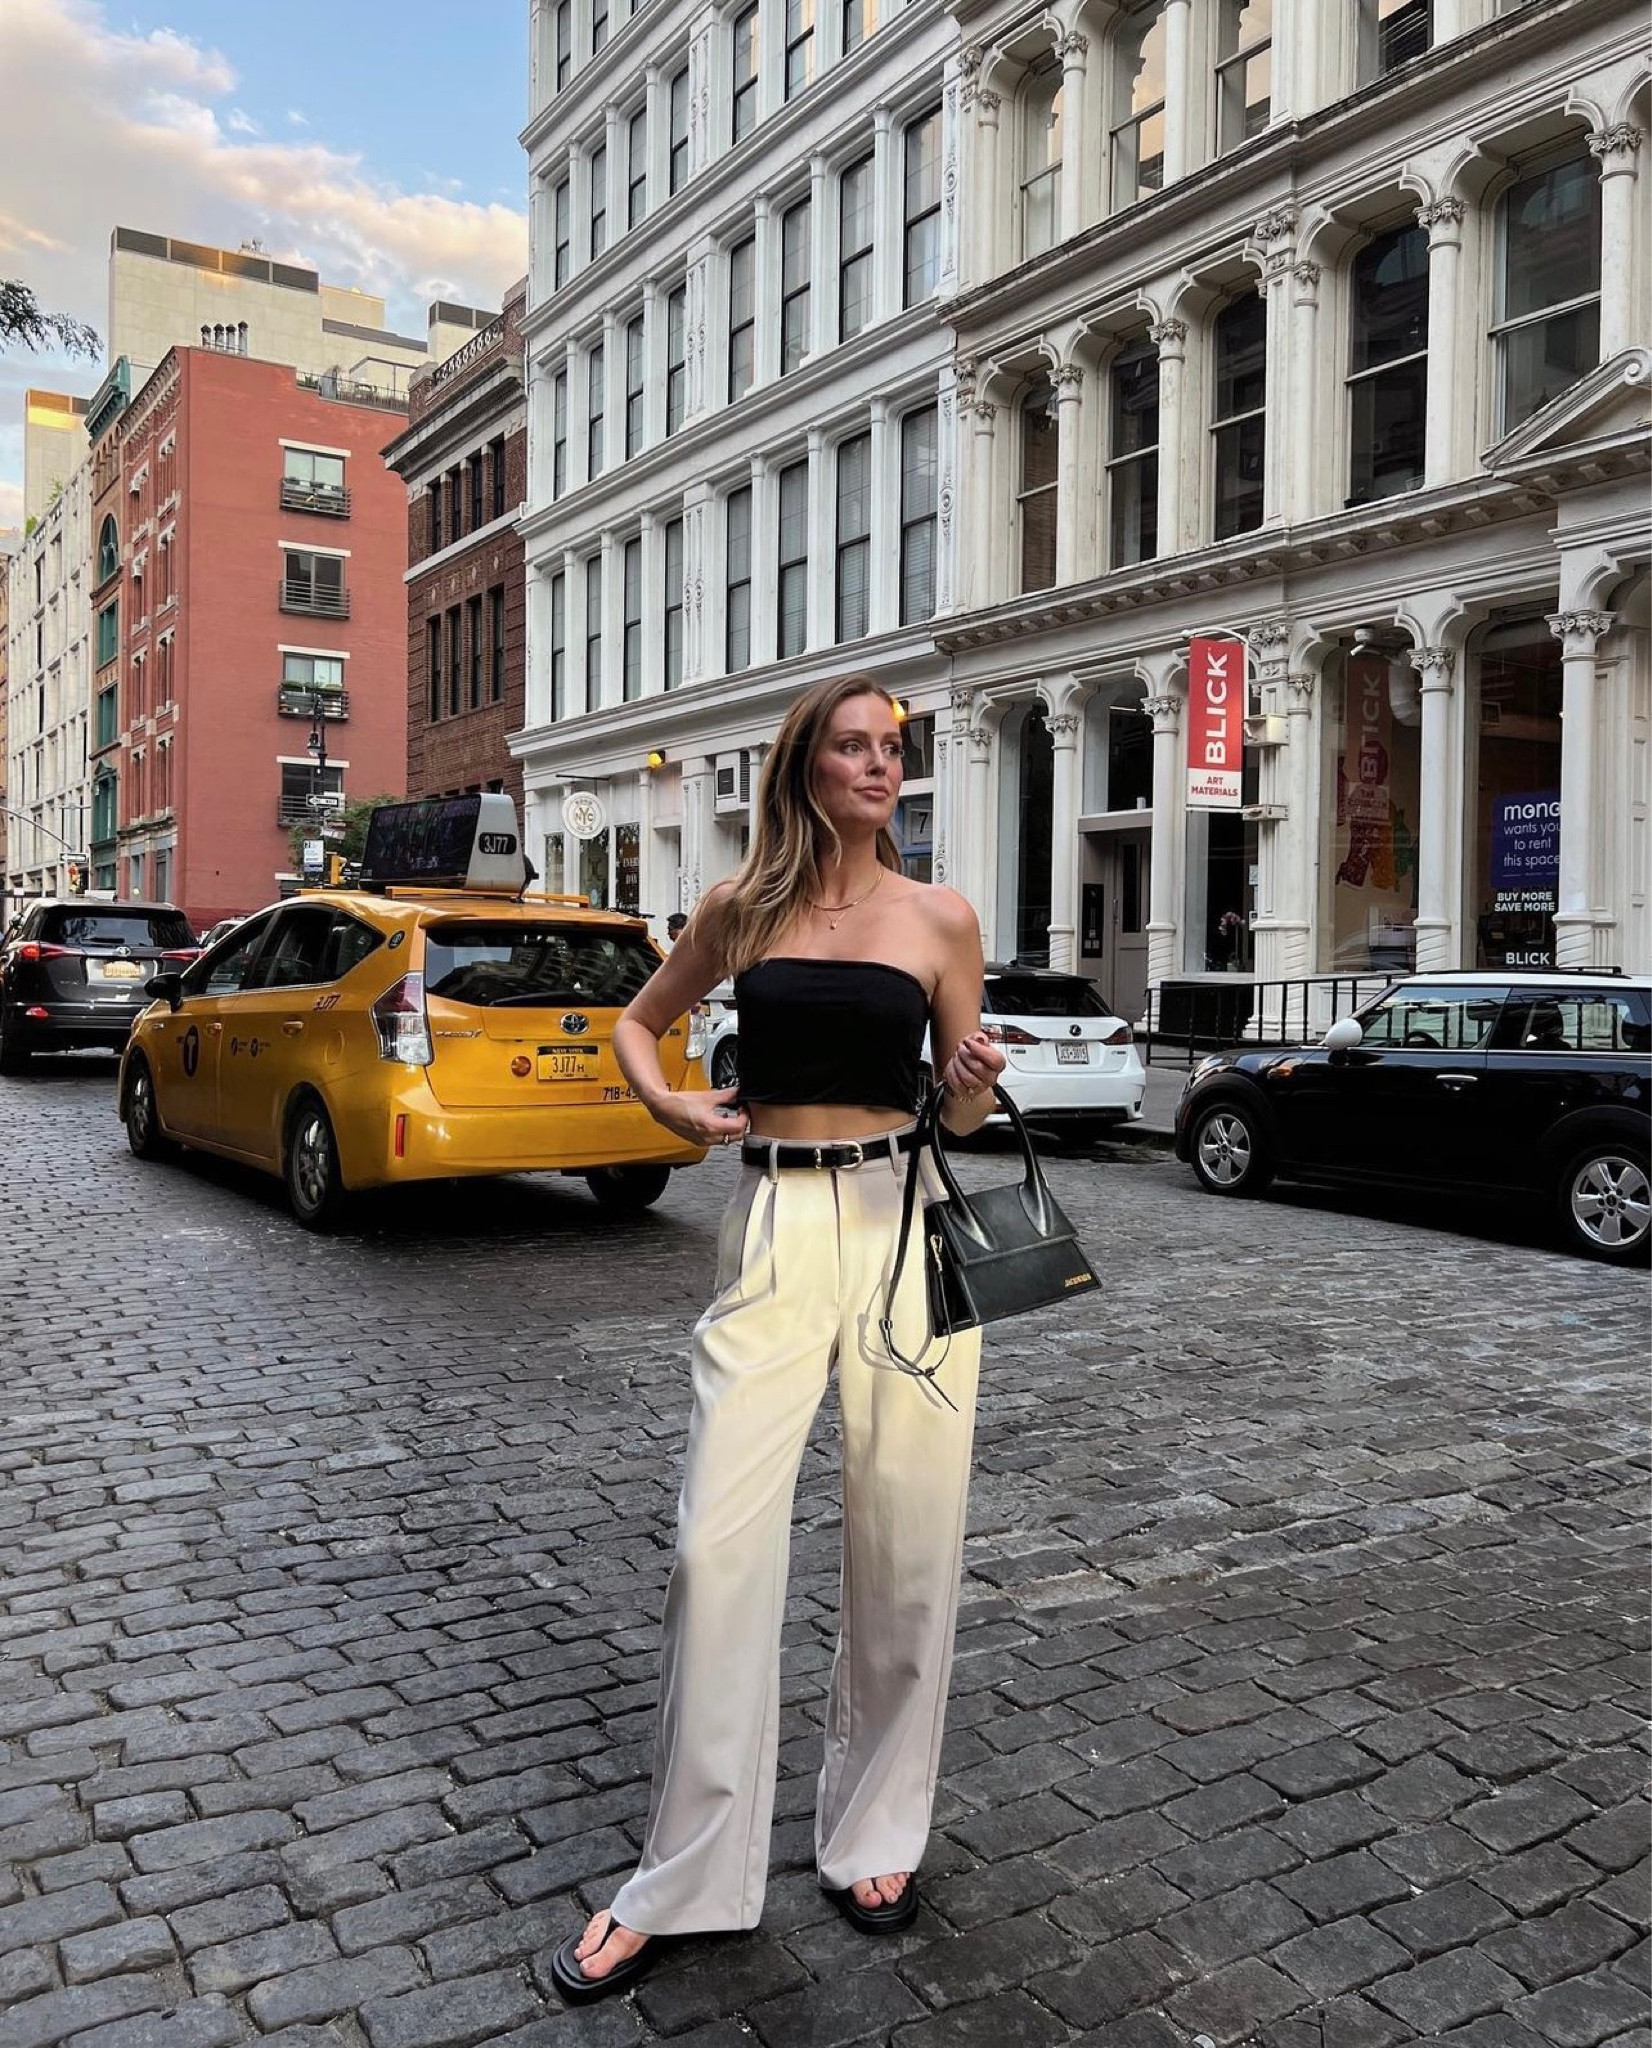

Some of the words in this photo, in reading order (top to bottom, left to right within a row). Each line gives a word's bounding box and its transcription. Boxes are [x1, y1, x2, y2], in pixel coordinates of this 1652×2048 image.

[1205, 653, 1227, 764] BLICK
[1206, 776, 1223, 785] ART
[1191, 786, 1239, 797] MATERIALS
[575, 808, 594, 825] NYC
[918, 812, 928, 834] 7
[1504, 823, 1537, 835] wants
[484, 835, 508, 853] 3J77
[1514, 838, 1526, 850] to
[1529, 837, 1552, 849] rent
[1504, 854, 1522, 867] this
[1525, 854, 1561, 869] space
[1497, 892, 1518, 901] BUY
[1521, 891, 1552, 901] MORE
[1494, 902, 1521, 911] SAVE
[1524, 902, 1555, 911] MORE
[1505, 952, 1550, 965] BLICK
